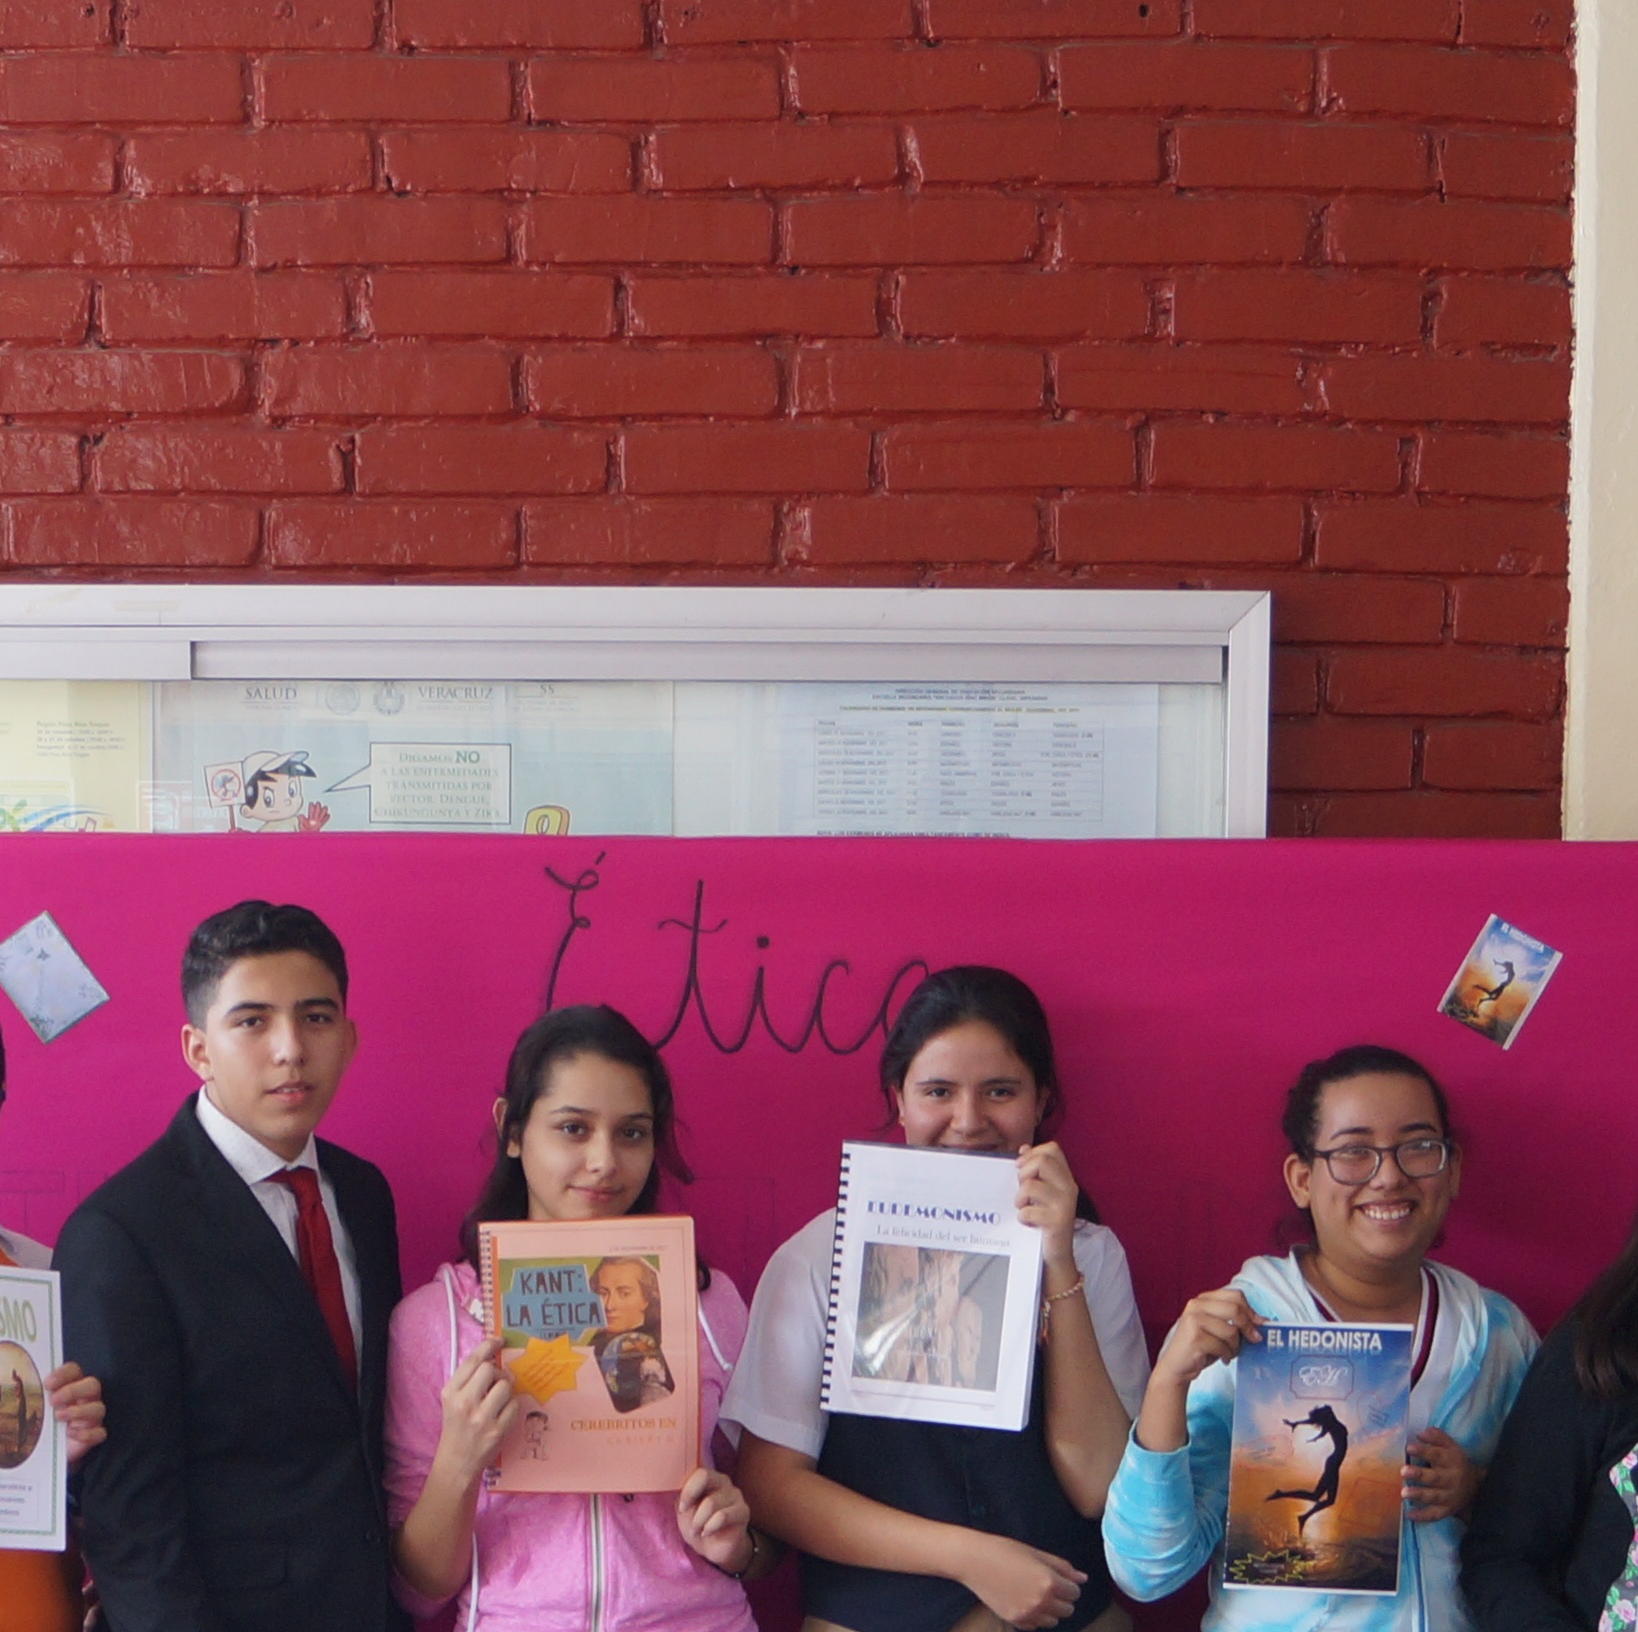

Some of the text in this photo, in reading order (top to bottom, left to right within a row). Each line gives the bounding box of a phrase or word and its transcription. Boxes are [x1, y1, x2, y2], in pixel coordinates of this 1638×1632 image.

[245, 686, 297, 699] SALUD
[417, 686, 494, 700] VERACRUZ
[455, 750, 481, 764] NO
[413, 768, 499, 777] ENFERMEDADES
[386, 781, 468, 790] TRANSMITIDAS
[866, 1200, 1001, 1226] EUDEMONISMO
[892, 1227, 933, 1241] felicidad
[935, 1229, 950, 1241] del
[520, 1269, 584, 1296] KANT:
[506, 1299, 602, 1328] LA ÉTICA
[1267, 1330, 1382, 1350] EL HEDONISTA
[658, 1416, 677, 1429] EN
